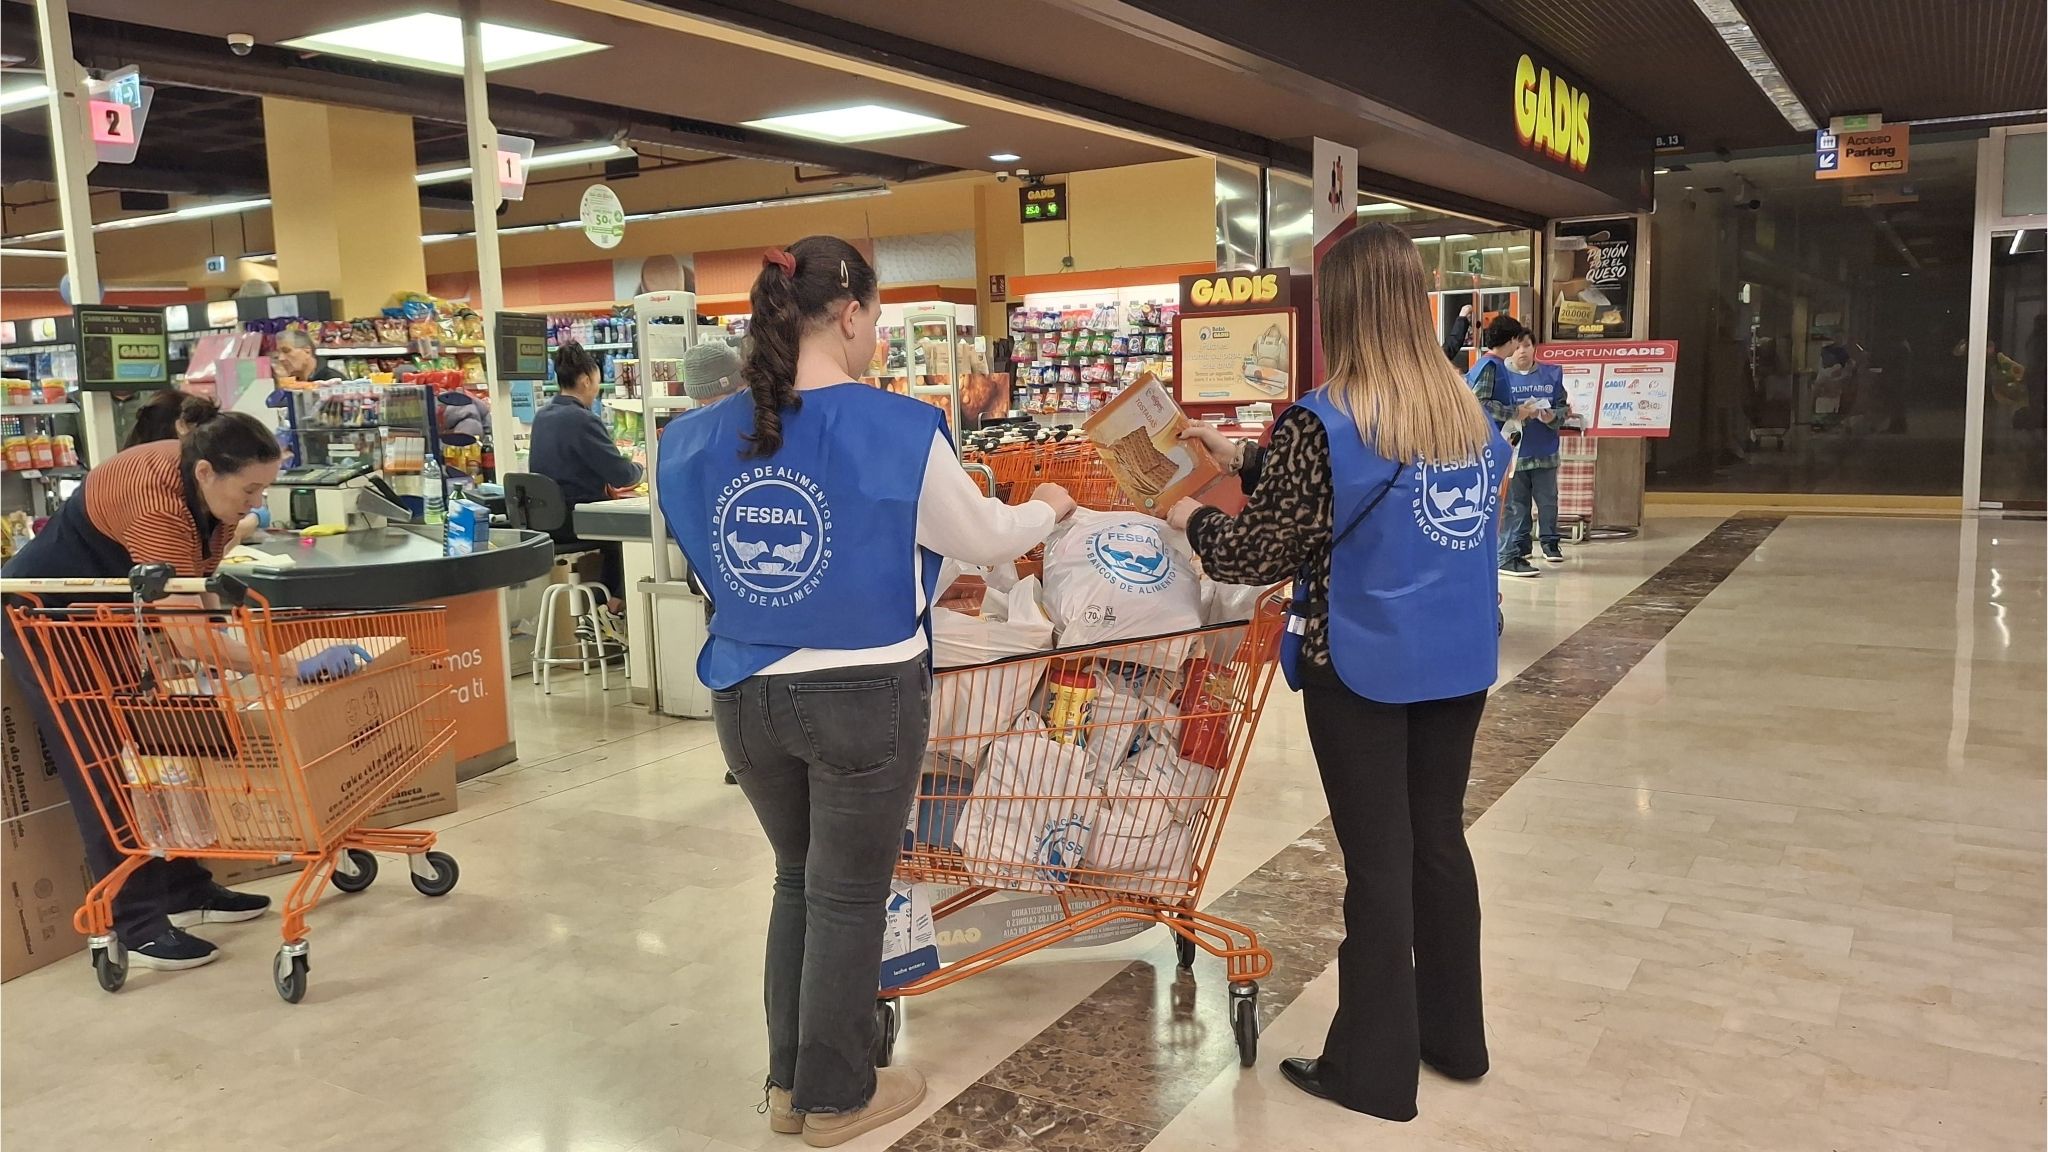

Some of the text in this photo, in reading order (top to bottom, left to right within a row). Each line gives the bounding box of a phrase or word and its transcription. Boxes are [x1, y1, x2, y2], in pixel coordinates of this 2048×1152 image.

[1514, 53, 1590, 170] GADIS
[106, 110, 121, 136] 2
[1668, 135, 1679, 145] 13
[1847, 135, 1892, 146] Acceso
[1846, 146, 1896, 158] Parking
[506, 157, 512, 178] 1
[1027, 189, 1056, 200] GADIS
[1587, 243, 1629, 262] PASIÓN
[1590, 258, 1624, 270] POR EL
[1585, 265, 1627, 283] QUESO
[1191, 274, 1278, 306] GADIS
[119, 345, 160, 359] GADIS
[1543, 348, 1665, 358] OPORTUNIGADIS
[1135, 398, 1158, 429] TOSTADAS
[712, 465, 832, 530] BANCOS DE ALIMENTOS
[735, 506, 808, 526] FESBAL
[1412, 498, 1448, 547] BANCOS
[1451, 539, 1466, 551] DE
[1108, 532, 1159, 549] FESBAL
[712, 543, 832, 608] BANCOS DE ALIMENTOS
[1086, 552, 1118, 585] BANCOS
[1119, 582, 1134, 593] DE
